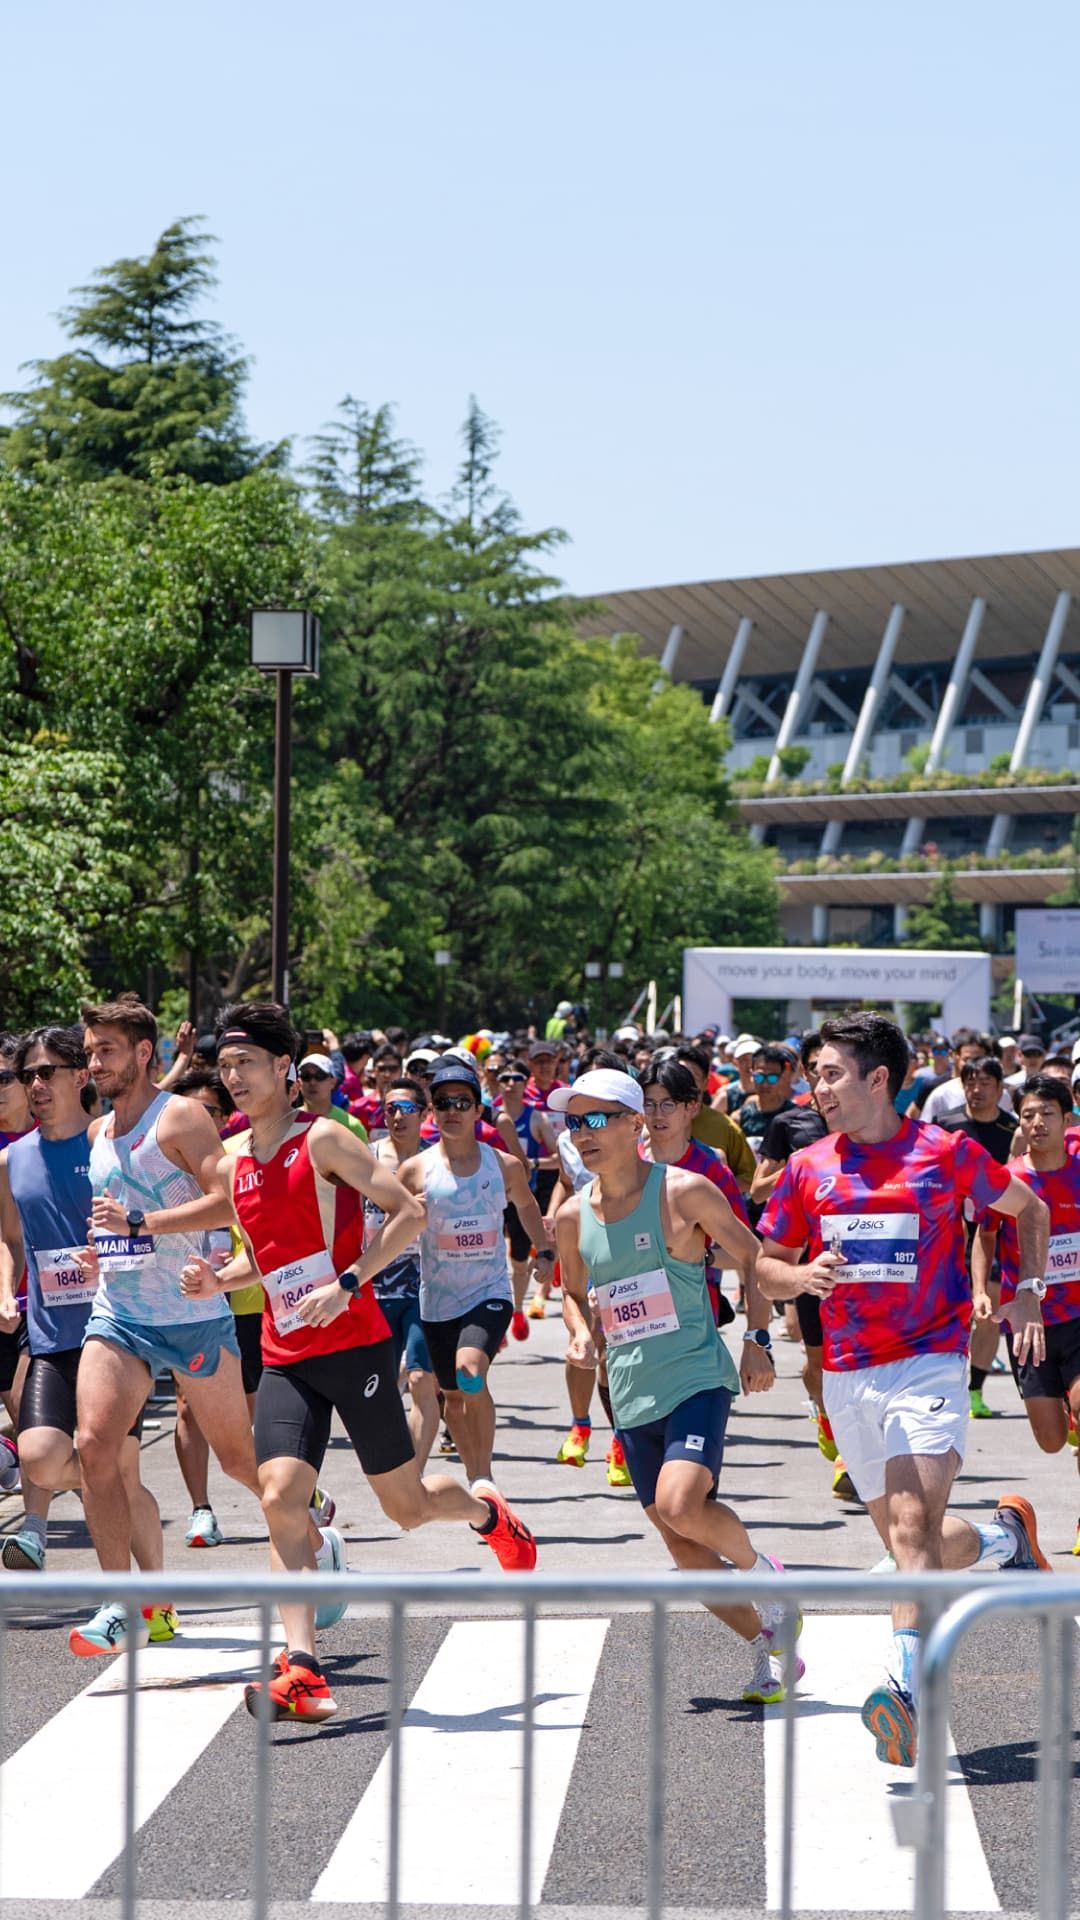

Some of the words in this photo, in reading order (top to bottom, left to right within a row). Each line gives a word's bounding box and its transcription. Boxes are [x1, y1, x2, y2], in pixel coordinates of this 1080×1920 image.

[718, 965, 757, 978] move
[762, 966, 792, 981] your
[797, 962, 837, 982] body,
[841, 966, 880, 979] move
[882, 967, 916, 983] your
[920, 964, 957, 981] mind
[859, 1221, 885, 1230] asics
[456, 1233, 484, 1247] 1828
[133, 1243, 152, 1254] 1805
[894, 1252, 915, 1263] 1817
[1050, 1252, 1078, 1267] 1847
[284, 1265, 304, 1280] asics
[858, 1268, 880, 1278] Speed
[886, 1268, 904, 1276] Race
[617, 1281, 638, 1294] asics
[614, 1301, 647, 1323] 1851
[626, 1326, 646, 1338] Speed
[650, 1322, 666, 1331] Race
